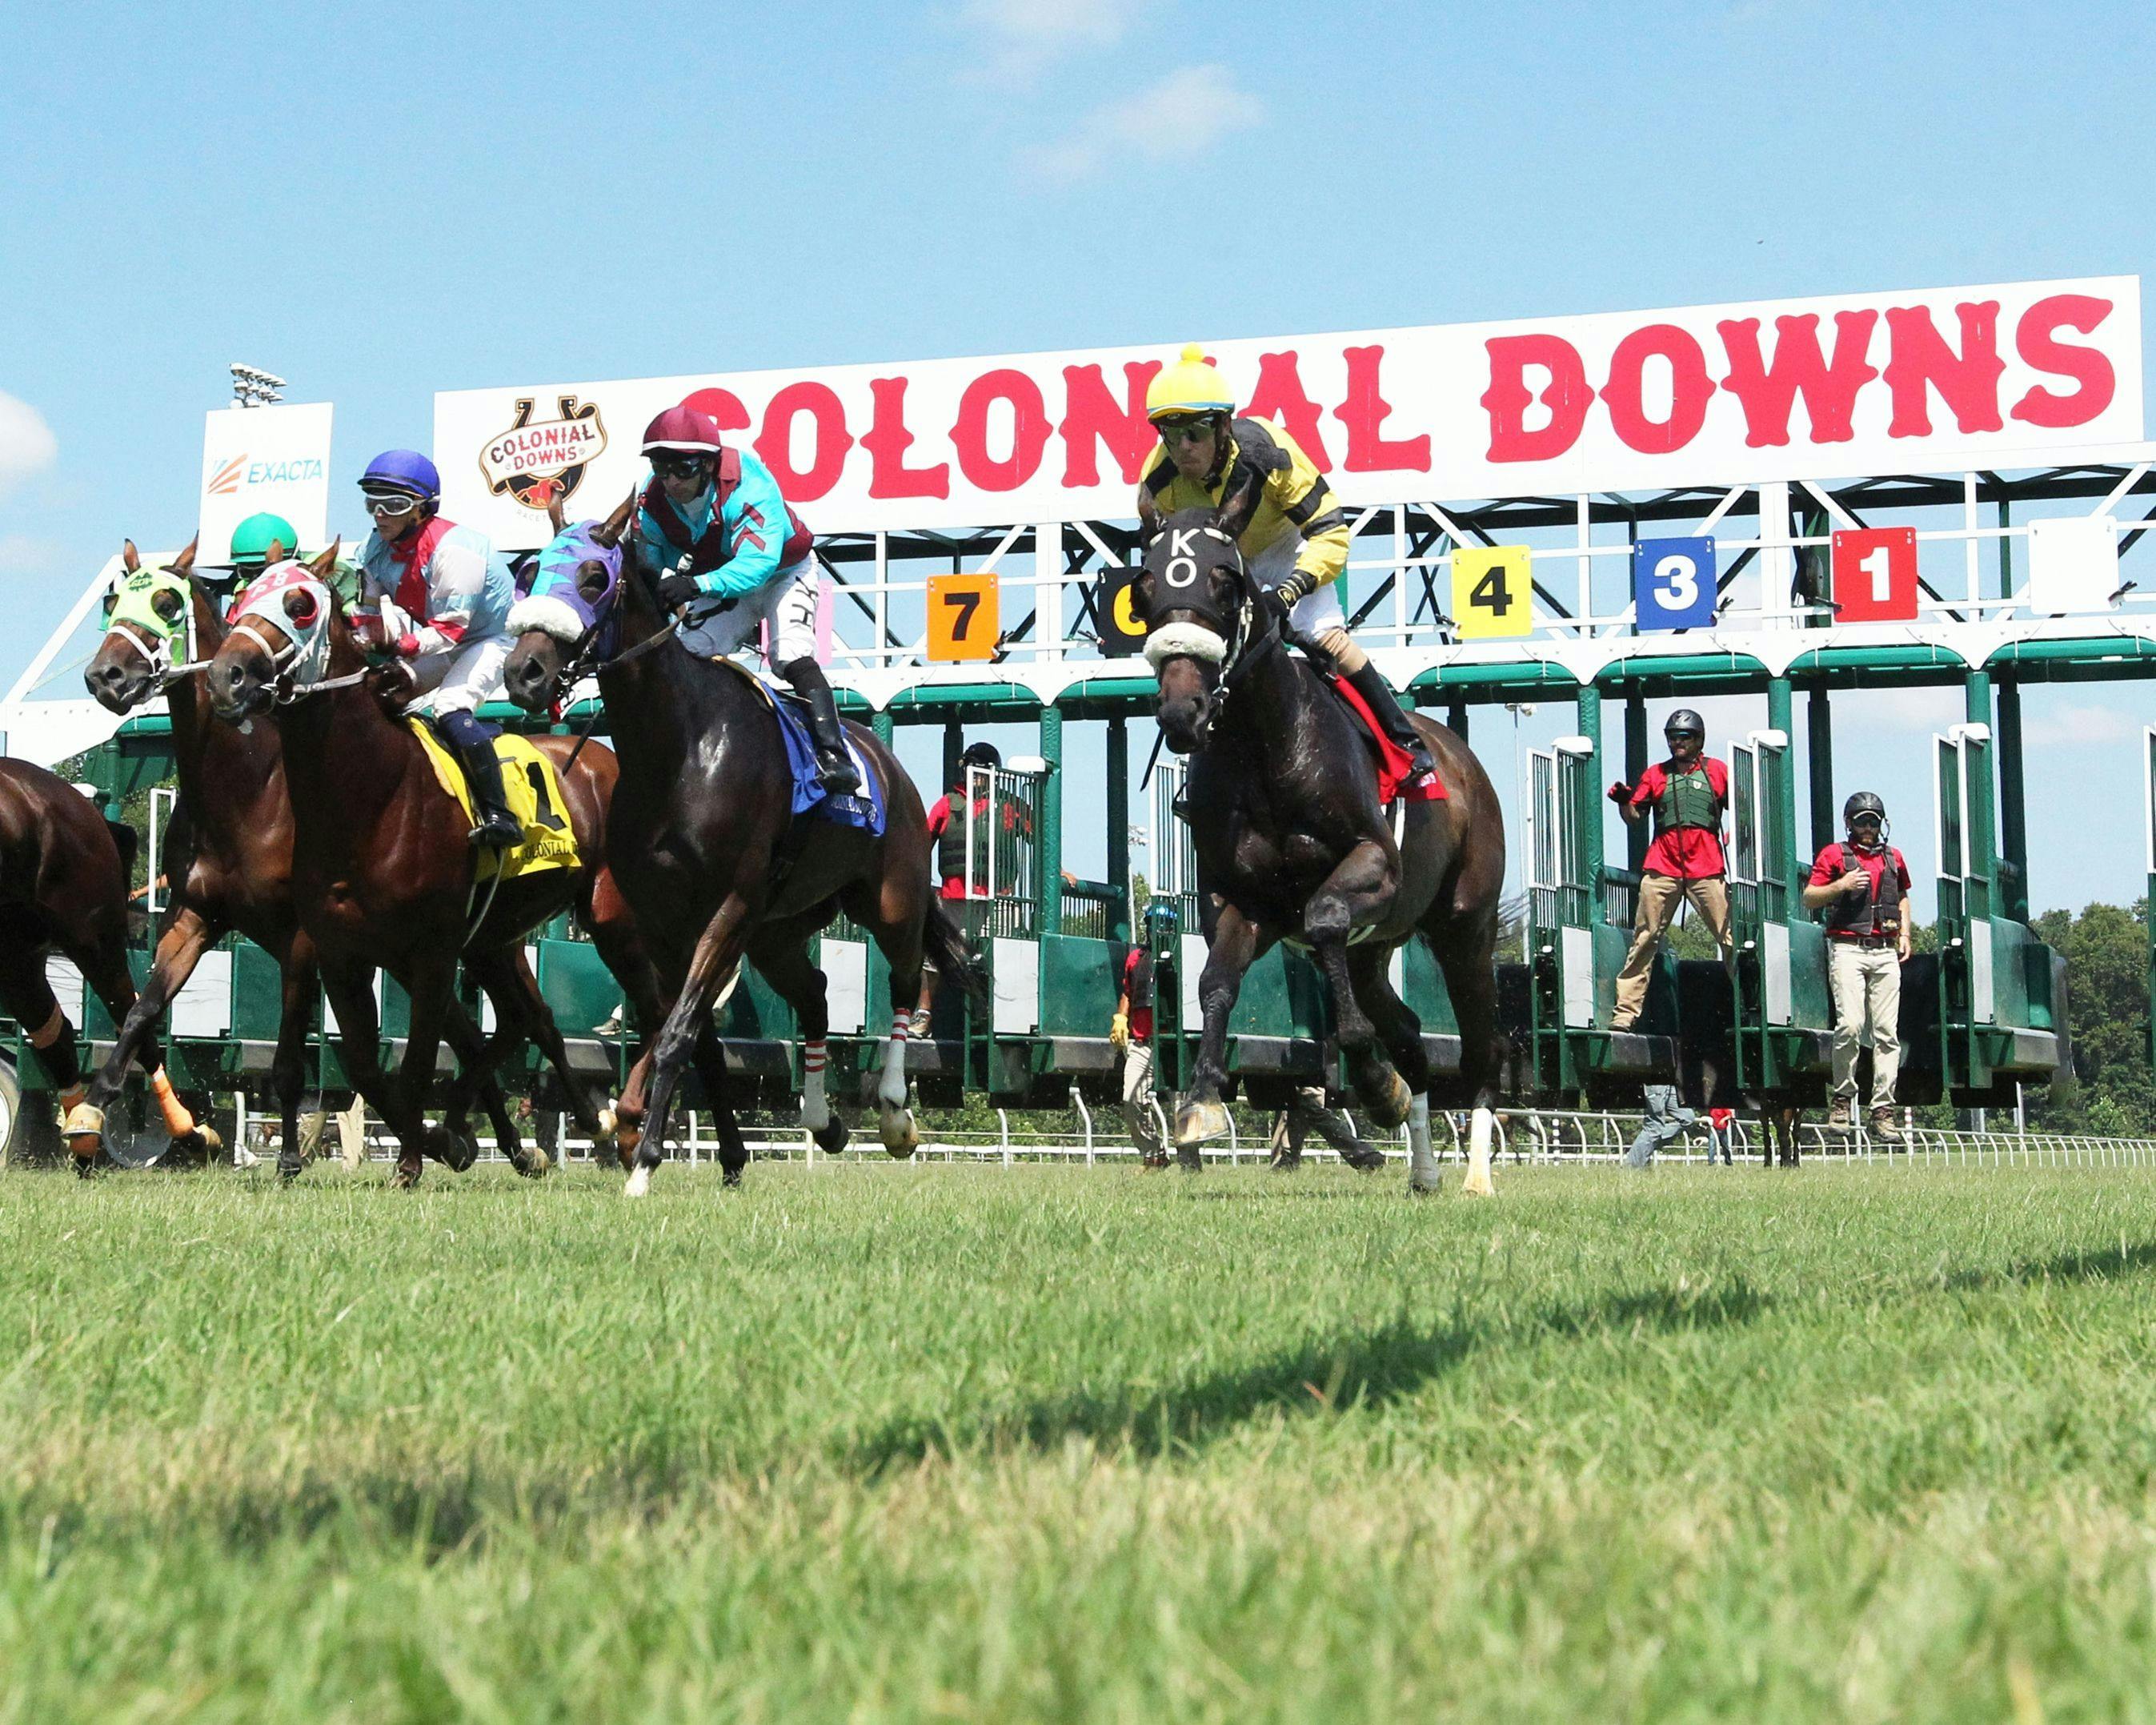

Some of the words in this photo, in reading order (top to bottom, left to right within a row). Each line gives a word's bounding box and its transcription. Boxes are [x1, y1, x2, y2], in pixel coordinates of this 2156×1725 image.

[679, 345, 1432, 503] OLONAL
[1481, 295, 2115, 463] DOWNS
[491, 423, 595, 464] COLONIAL
[513, 446, 577, 471] DOWNS
[247, 459, 323, 484] EXACTA
[1171, 528, 1201, 558] K
[1165, 557, 1197, 588] O
[1469, 566, 1513, 616] 4
[1653, 555, 1698, 610] 3
[1860, 547, 1890, 601] 1
[944, 592, 980, 641] 7
